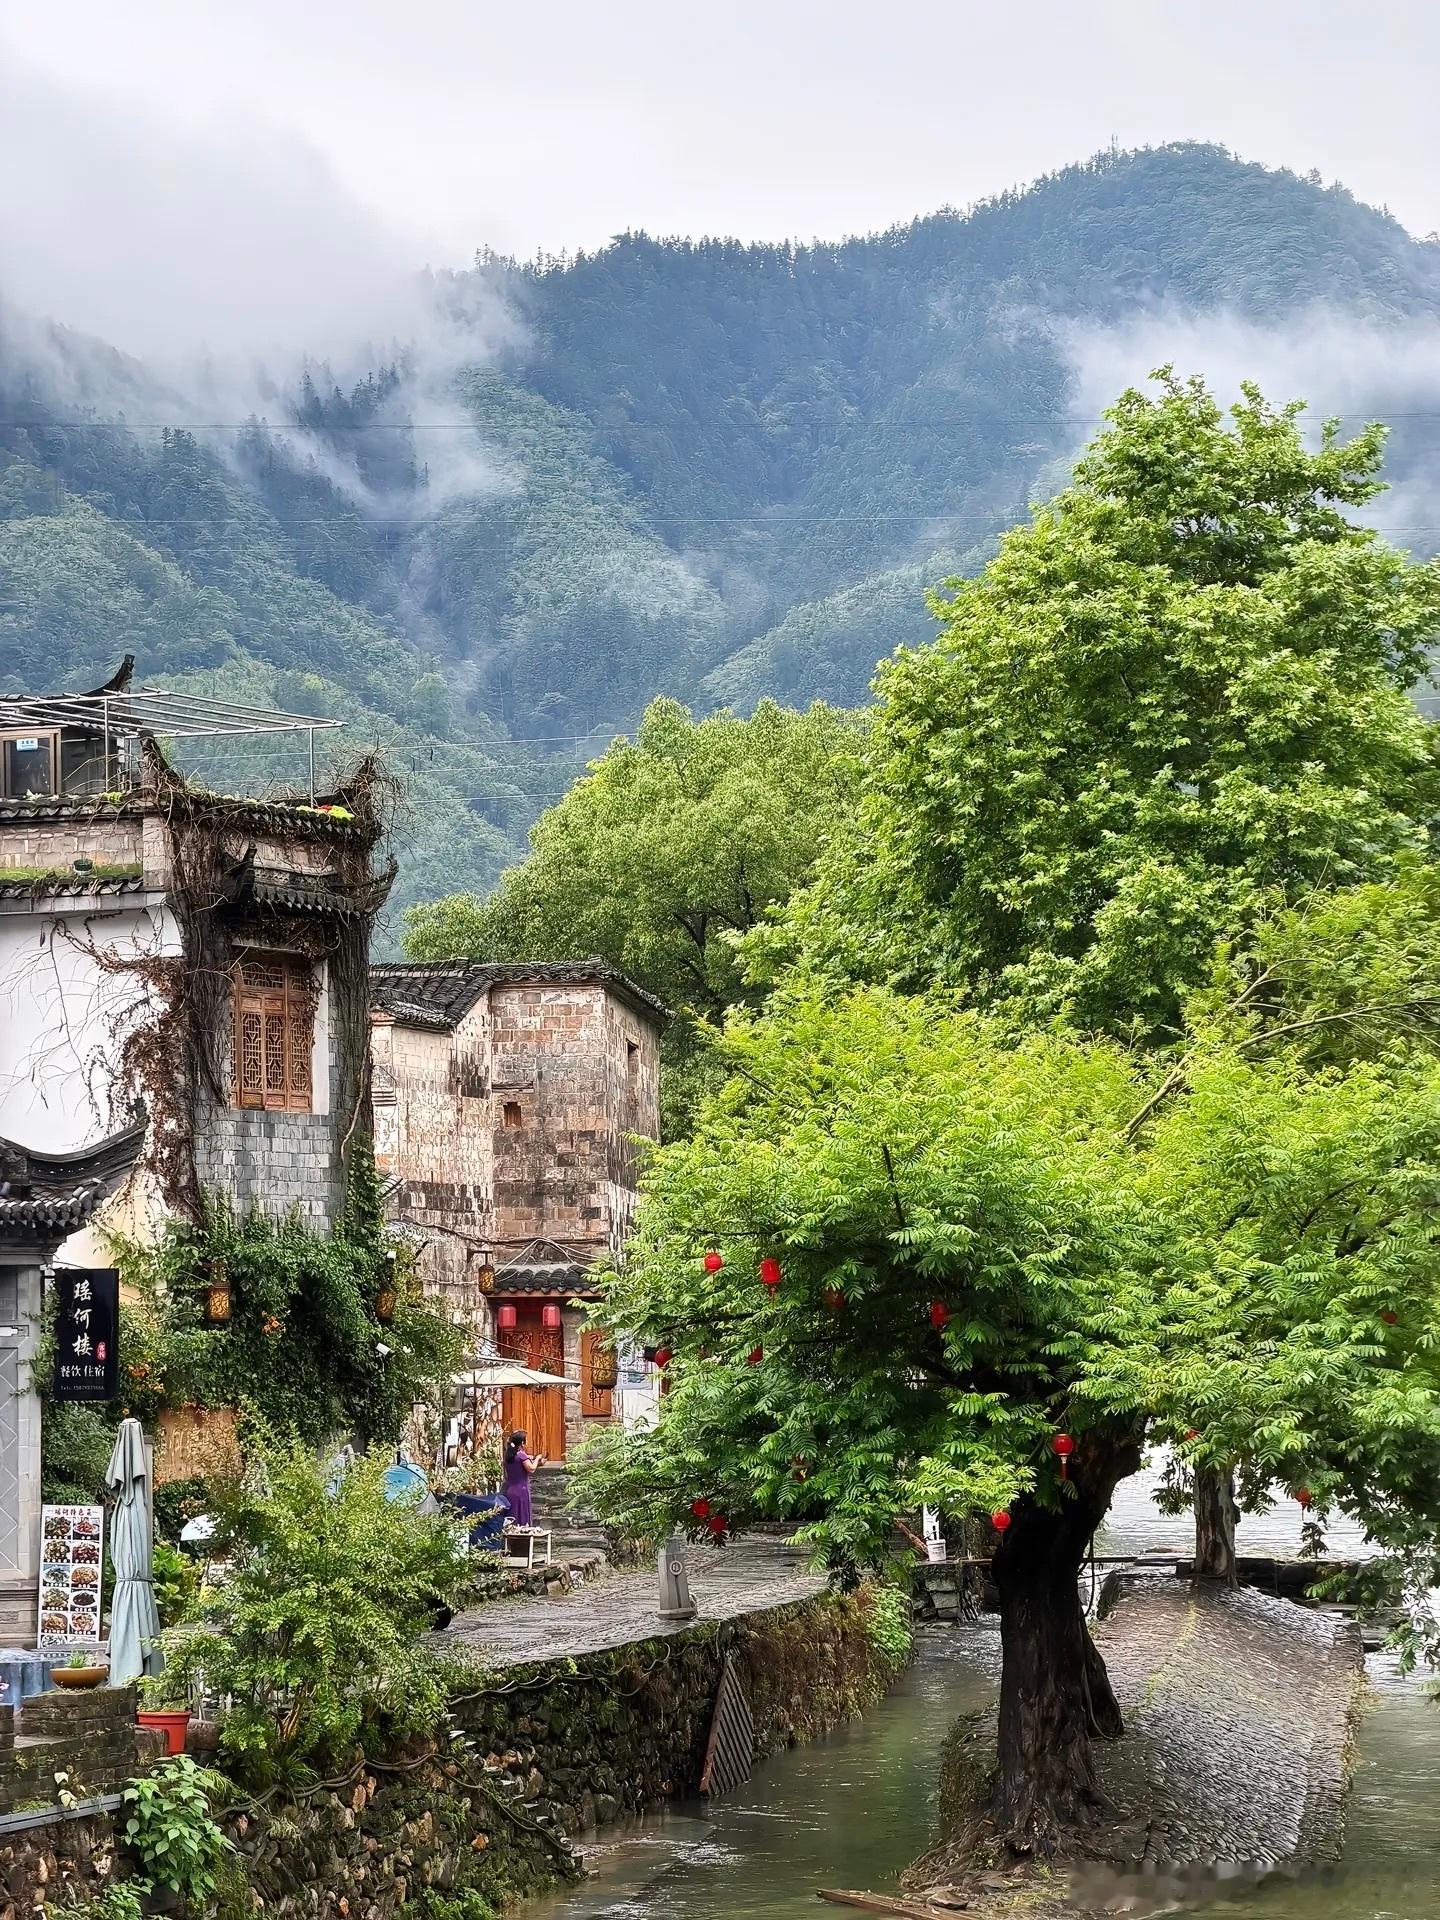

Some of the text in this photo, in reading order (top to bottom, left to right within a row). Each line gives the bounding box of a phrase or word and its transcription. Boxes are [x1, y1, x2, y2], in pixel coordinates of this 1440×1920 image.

[72, 1279, 94, 1357] 瑶何楼
[60, 1364, 82, 1377] 餐饮
